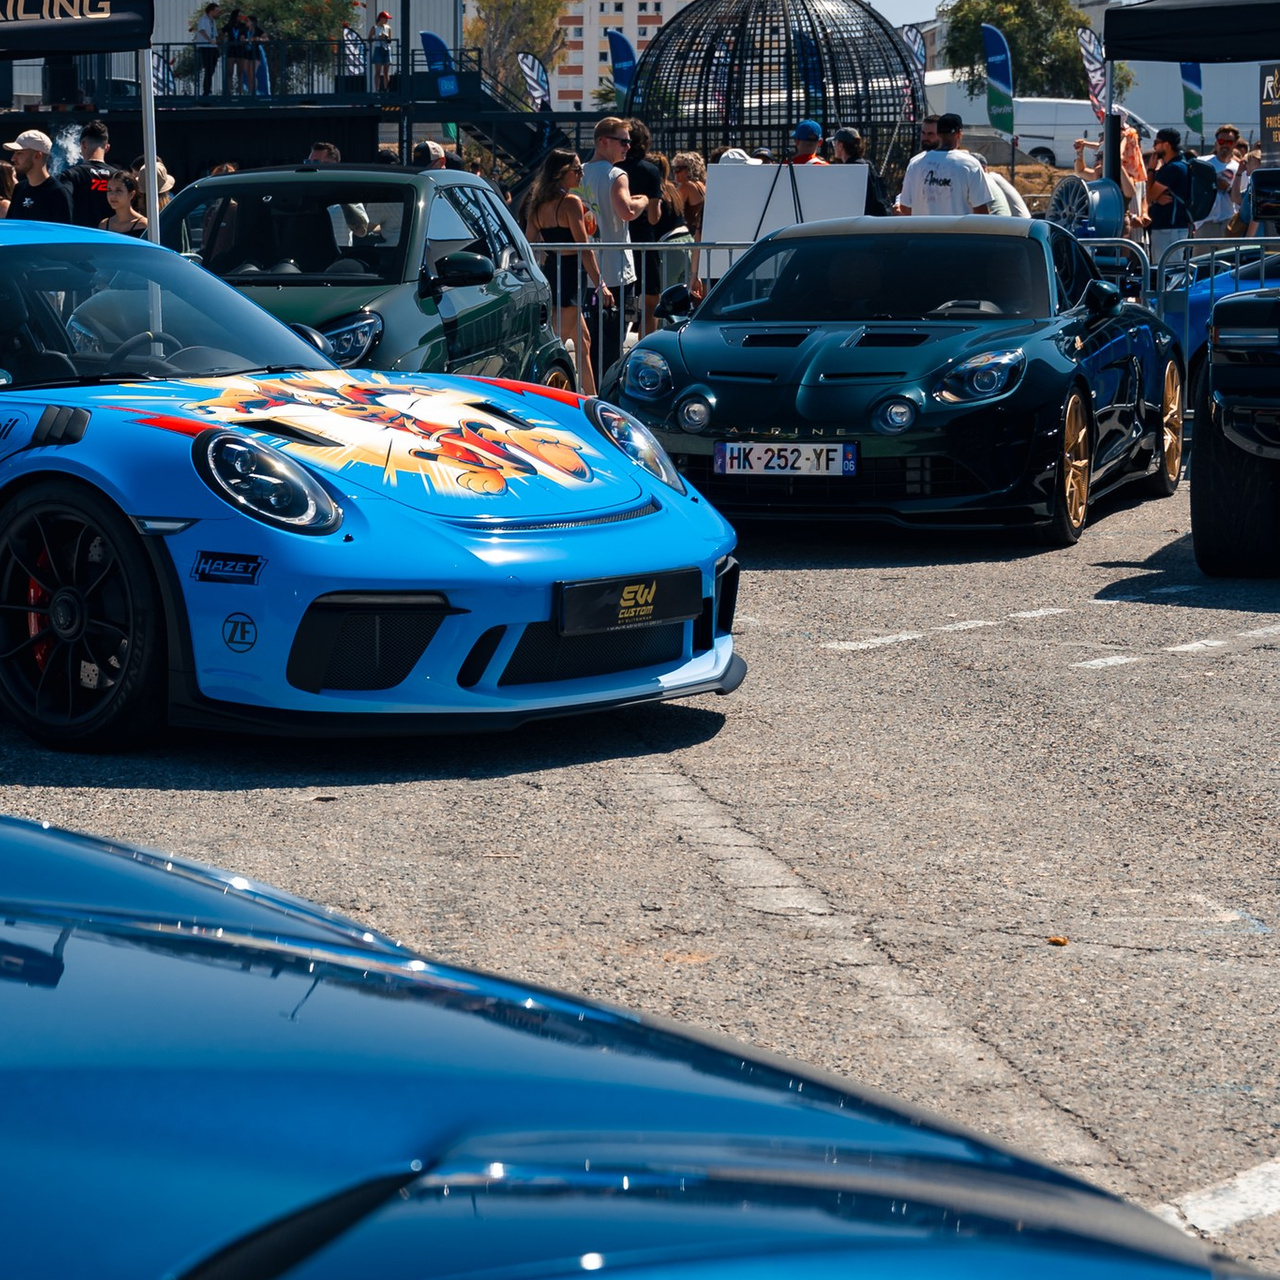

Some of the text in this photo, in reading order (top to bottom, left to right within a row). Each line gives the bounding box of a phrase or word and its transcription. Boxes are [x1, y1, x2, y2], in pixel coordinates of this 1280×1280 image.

[990, 105, 1013, 117] Sprite
[729, 426, 845, 436] ALPINE
[728, 447, 838, 471] HK-252-YF
[842, 460, 855, 472] 06
[198, 558, 259, 574] HAZET
[618, 605, 654, 619] CUSTOM
[224, 620, 256, 645] ZF
